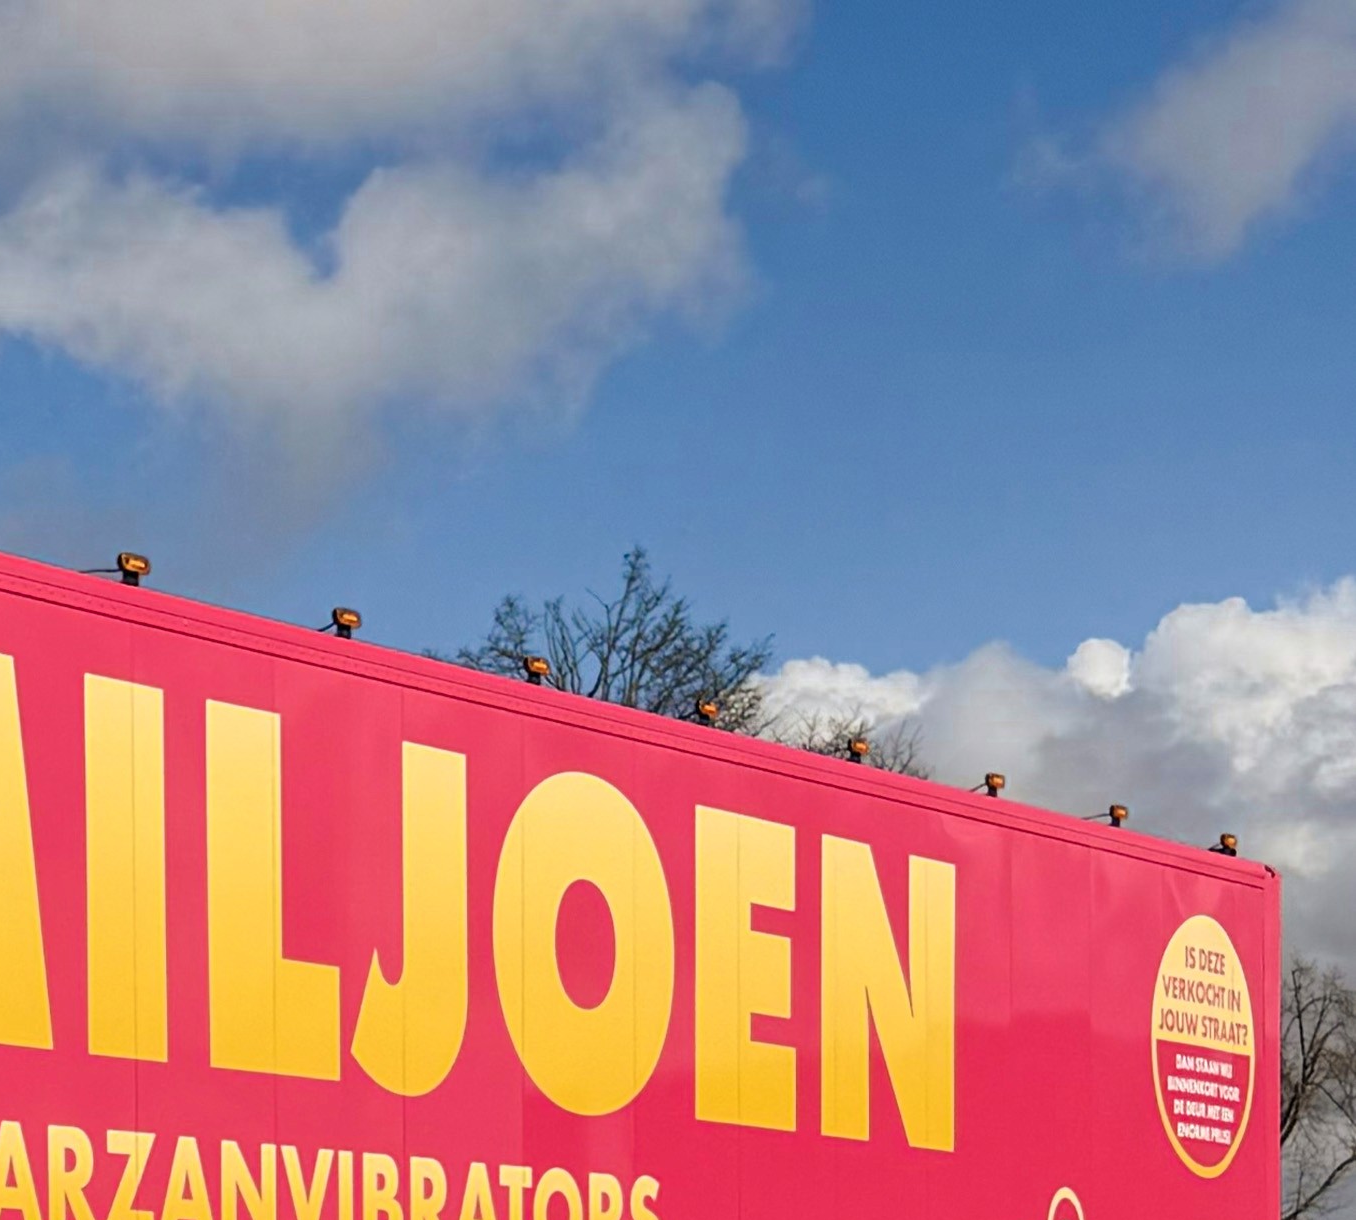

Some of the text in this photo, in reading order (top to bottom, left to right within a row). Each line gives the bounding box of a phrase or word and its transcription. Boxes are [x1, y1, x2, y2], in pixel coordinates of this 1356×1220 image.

[1184, 945, 1226, 976] IS DEZE
[1162, 975, 1241, 1012] VERKOCHT IN
[1158, 1007, 1248, 1046] JOUW STRAAT?
